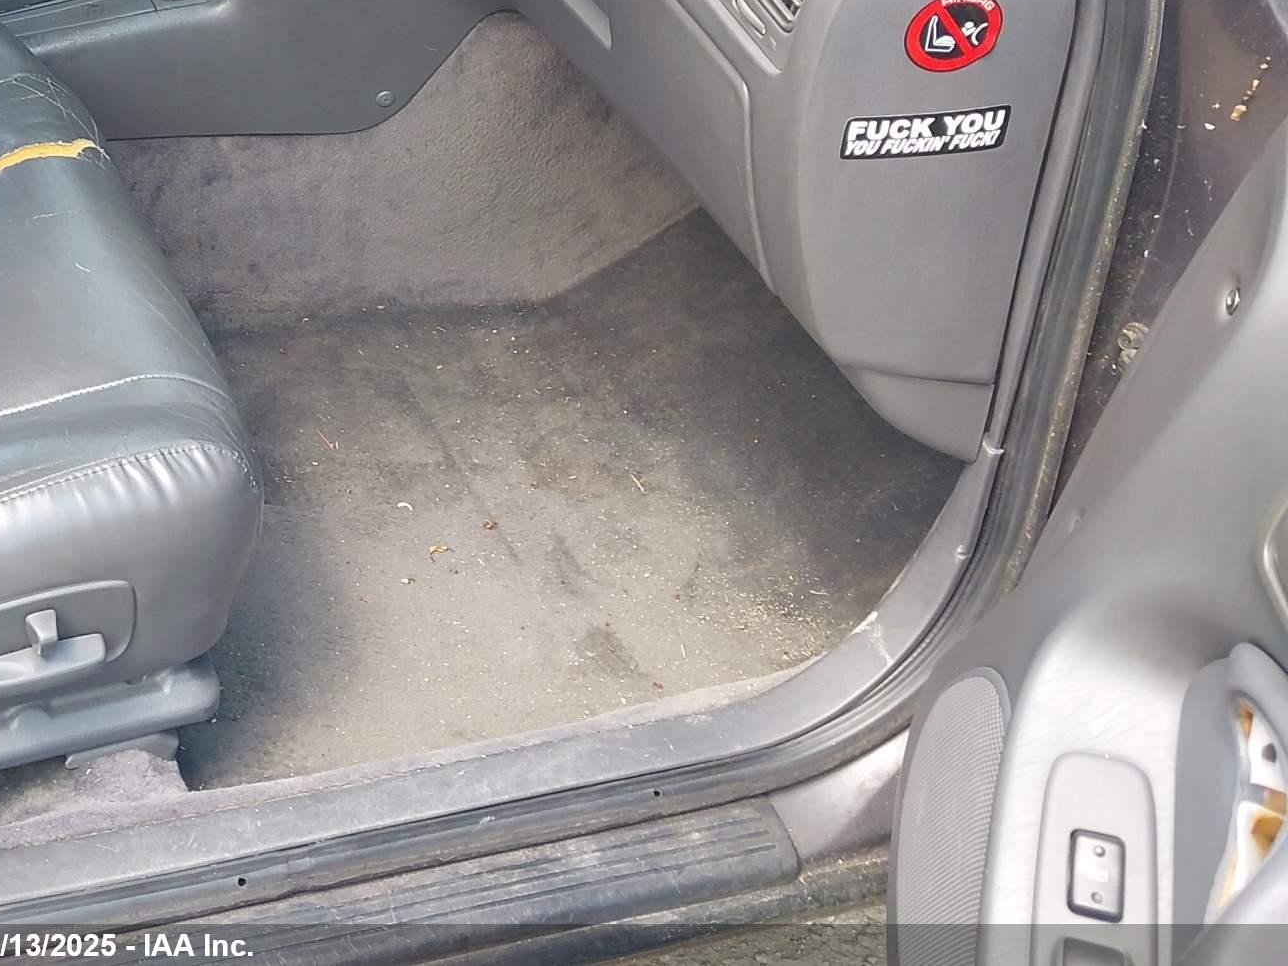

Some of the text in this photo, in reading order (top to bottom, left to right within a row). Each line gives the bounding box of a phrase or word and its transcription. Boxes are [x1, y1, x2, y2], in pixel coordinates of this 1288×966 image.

[847, 109, 1007, 142] FUCK YOU
[844, 139, 882, 157] YOU
